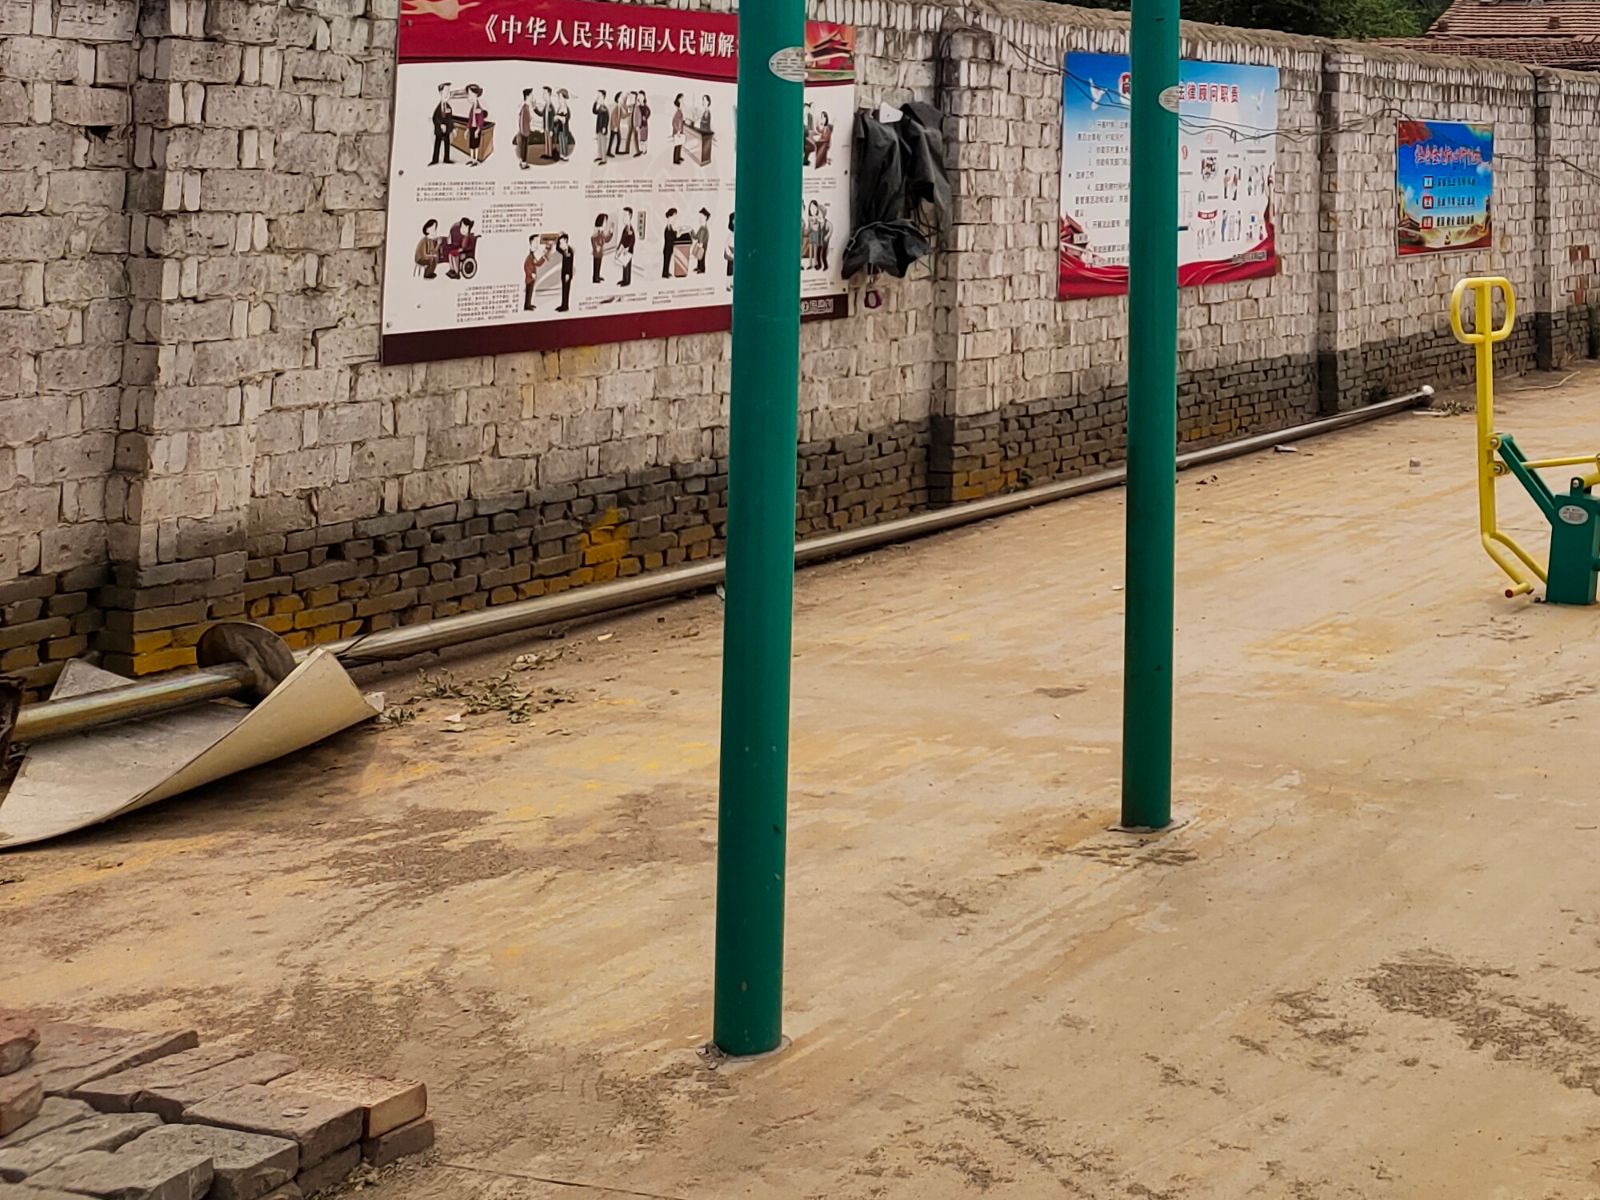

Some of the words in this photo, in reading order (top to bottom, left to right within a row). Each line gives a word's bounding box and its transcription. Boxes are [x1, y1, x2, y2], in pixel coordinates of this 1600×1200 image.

[484, 14, 738, 58] 《中华人民共和国人民调解
